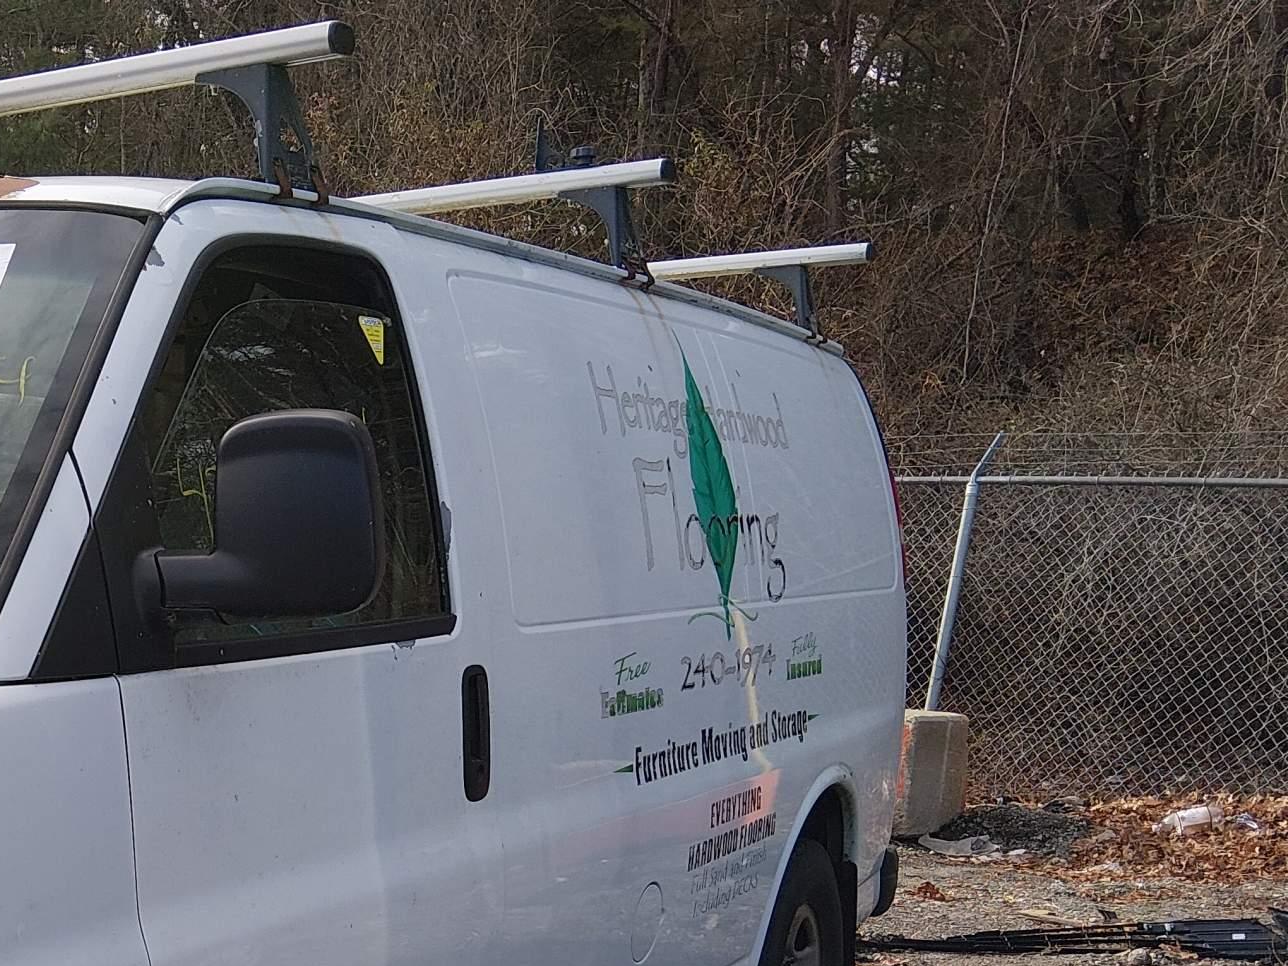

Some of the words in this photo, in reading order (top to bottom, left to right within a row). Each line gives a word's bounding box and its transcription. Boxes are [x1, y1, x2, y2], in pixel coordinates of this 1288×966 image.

[586, 360, 690, 459] Heritag
[631, 456, 787, 603] Flooring
[614, 651, 652, 686] Free
[680, 642, 776, 692] 240-1974
[635, 740, 699, 785] Furniture
[700, 722, 748, 764] Moving
[749, 720, 769, 751] and
[771, 708, 808, 744] Storage
[711, 785, 763, 829] EVERYTHING
[688, 829, 739, 872] HARDWOOD
[739, 813, 777, 850] FLOORING
